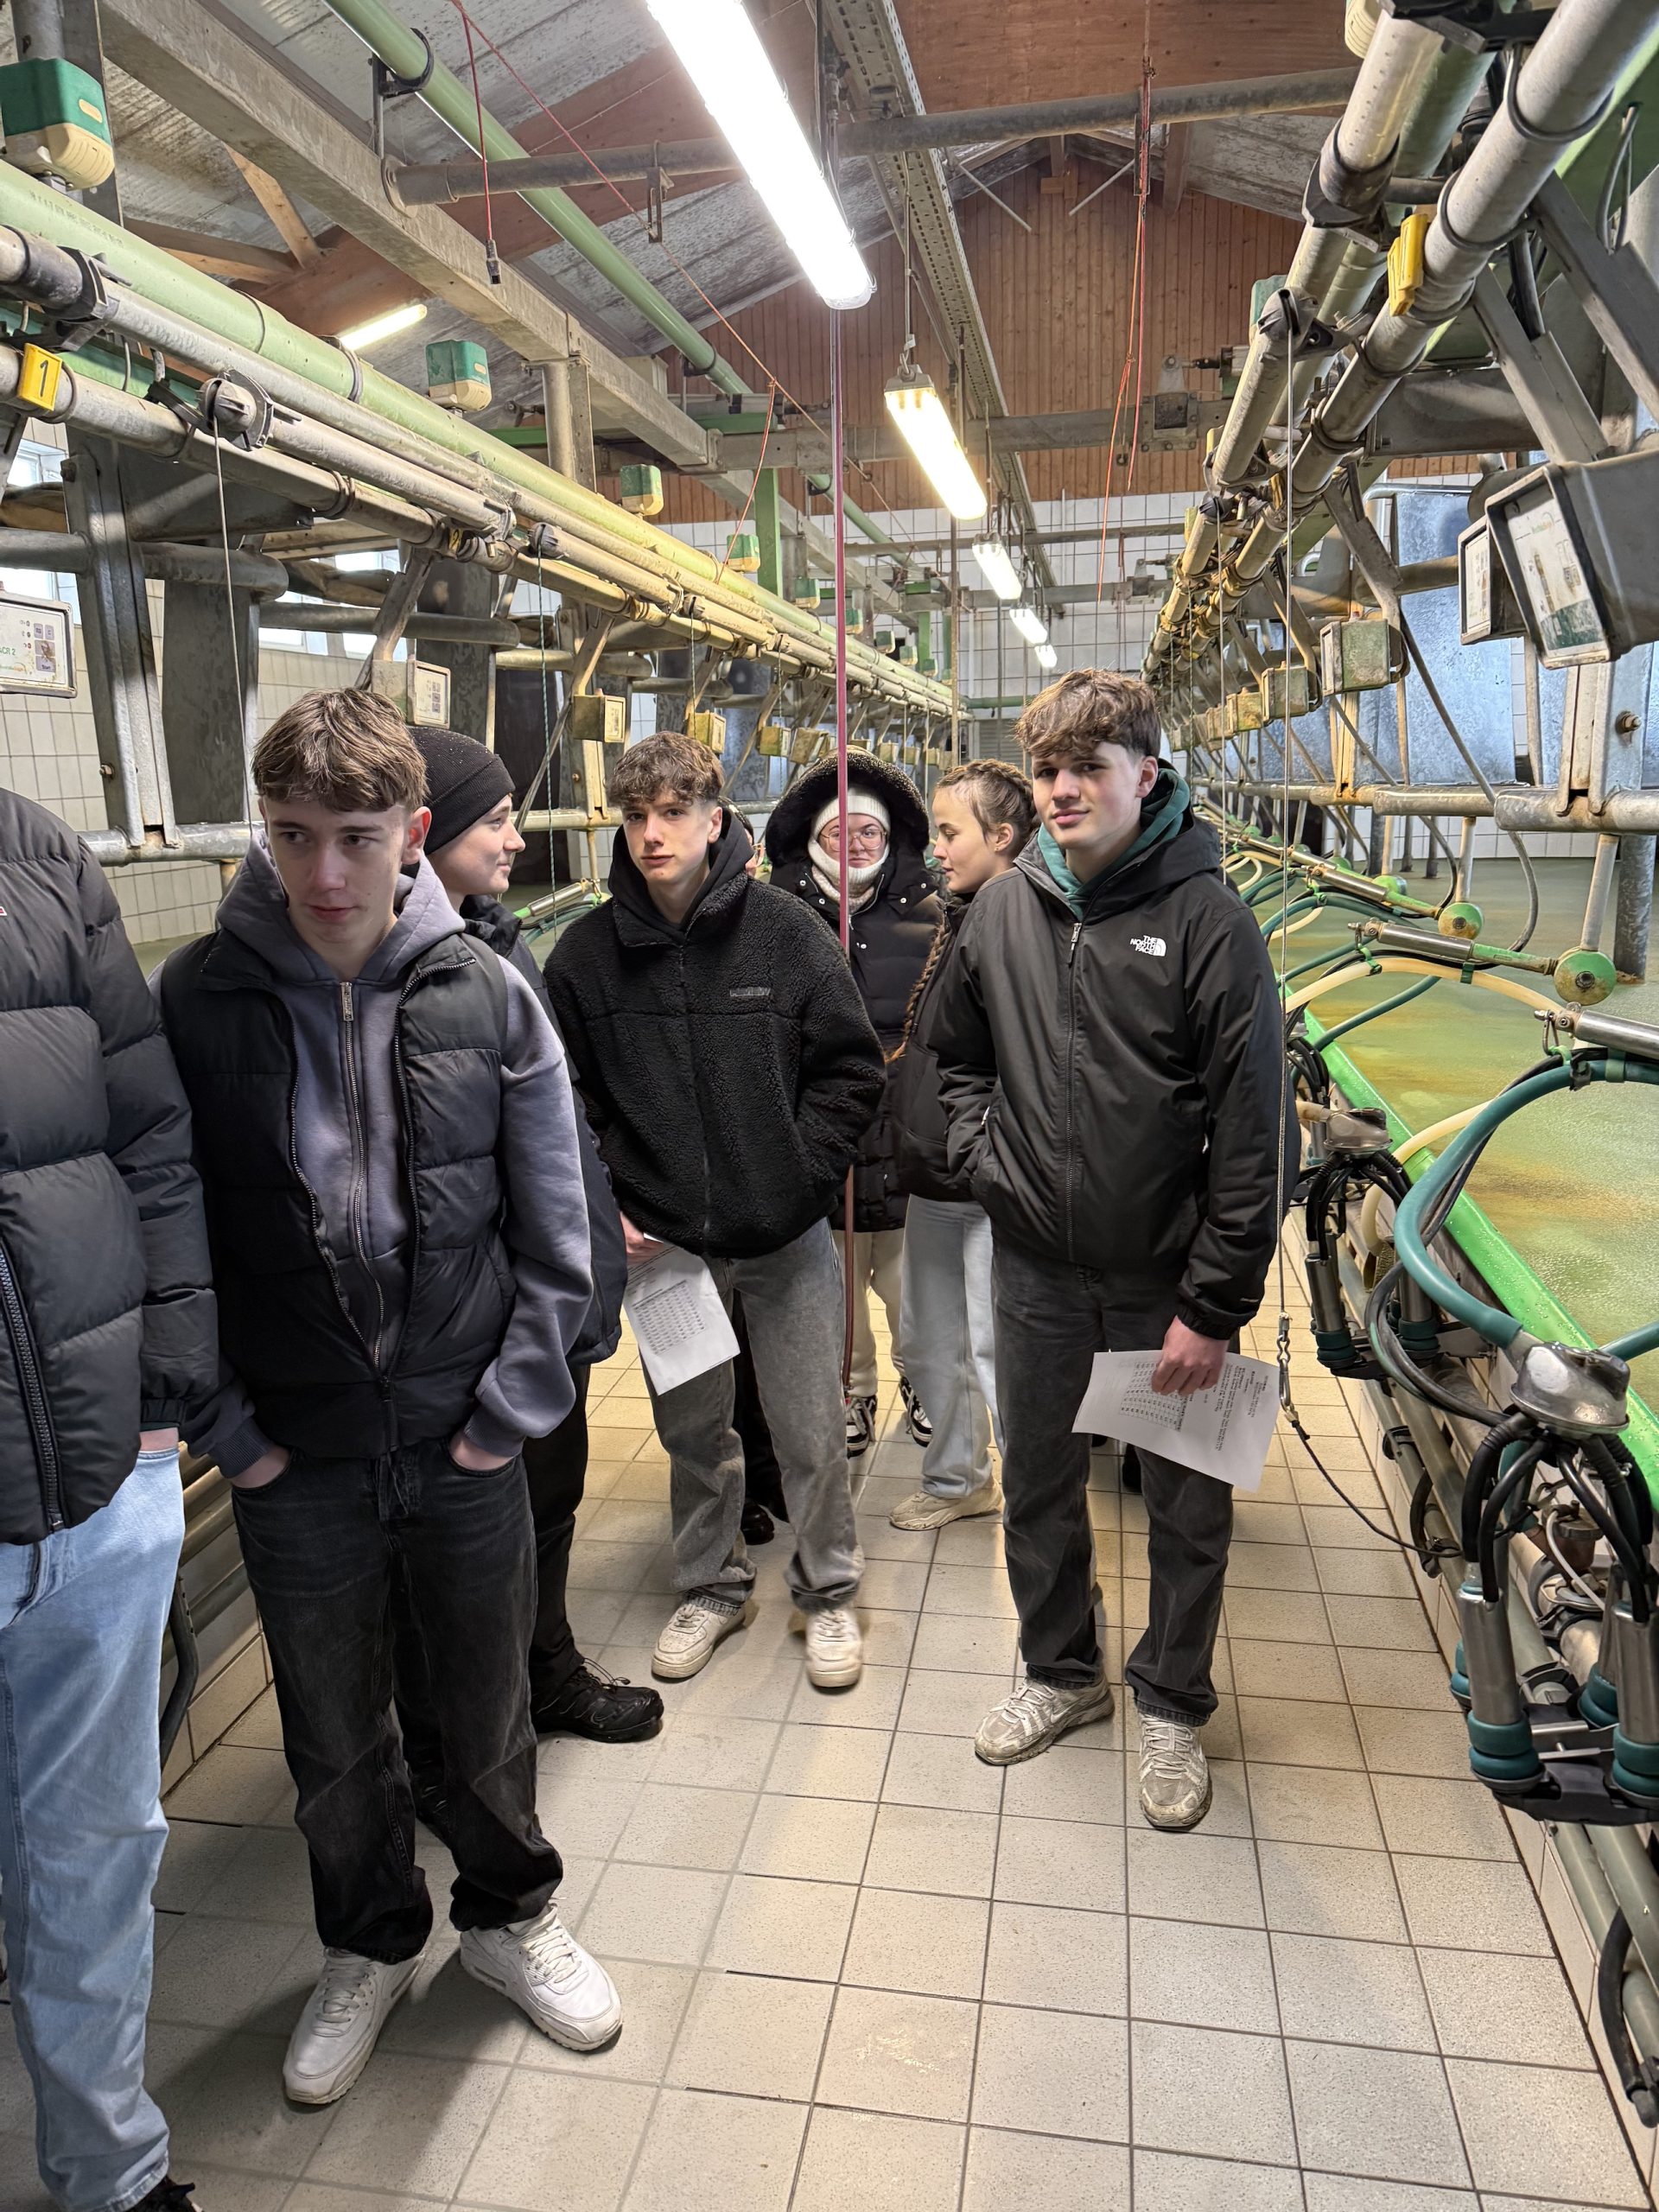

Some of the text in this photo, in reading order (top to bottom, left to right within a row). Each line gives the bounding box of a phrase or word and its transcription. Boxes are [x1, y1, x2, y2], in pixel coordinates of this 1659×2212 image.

[40, 359, 49, 397] 1
[1130, 938, 1156, 950] NORTH
[1143, 935, 1157, 944] THE
[1135, 945, 1154, 955] FACE
